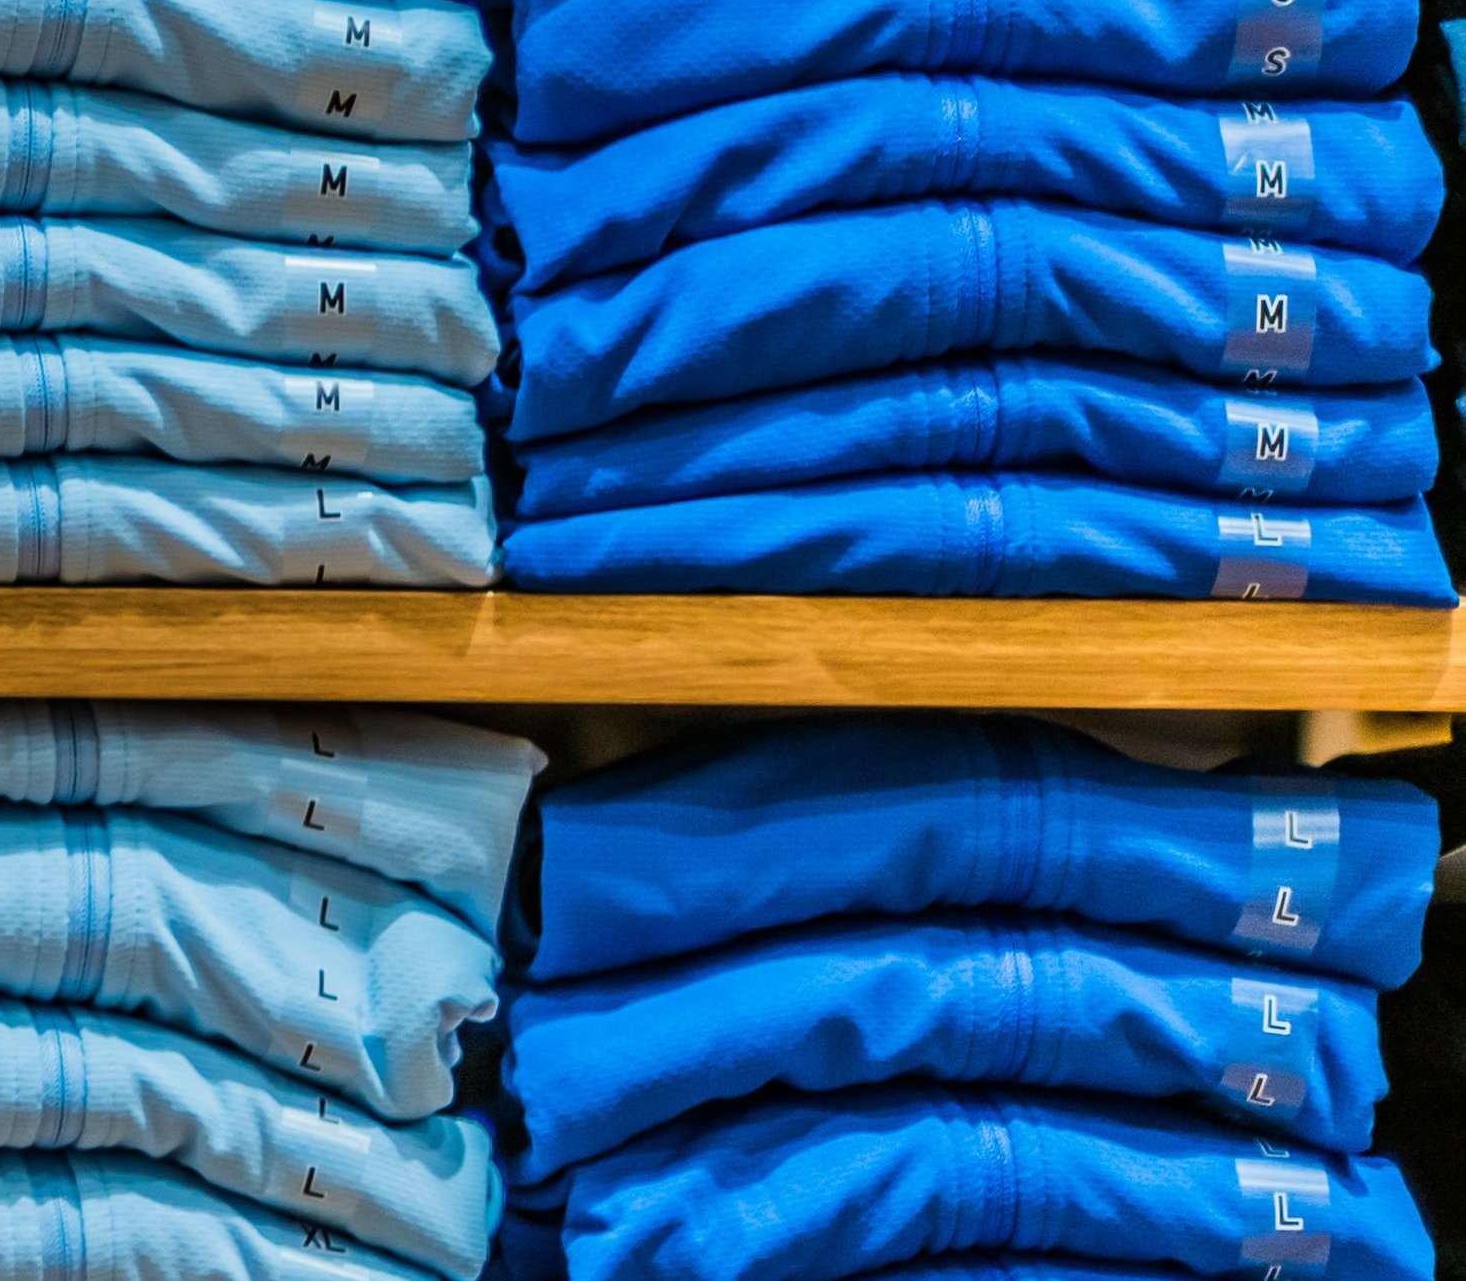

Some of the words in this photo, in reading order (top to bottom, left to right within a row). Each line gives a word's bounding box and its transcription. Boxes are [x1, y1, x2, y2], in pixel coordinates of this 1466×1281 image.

[346, 17, 370, 47] M
[1263, 48, 1290, 76] S
[326, 91, 356, 117] M
[321, 165, 347, 196] M
[1257, 161, 1287, 197] M
[320, 283, 345, 313] M
[1256, 294, 1288, 333] M
[316, 382, 340, 411] M
[1256, 421, 1288, 460] M
[317, 489, 341, 519] L
[1252, 513, 1282, 546] L
[312, 732, 335, 757] L
[304, 800, 325, 830] L
[1285, 811, 1312, 848] L
[320, 897, 339, 931] L
[1273, 887, 1299, 926] L
[319, 969, 338, 1001] L
[1263, 995, 1291, 1035] L
[300, 1044, 320, 1071] L
[1247, 1074, 1275, 1106] L
[320, 1097, 340, 1124] L
[304, 1167, 325, 1198] L
[1275, 1193, 1303, 1230] L
